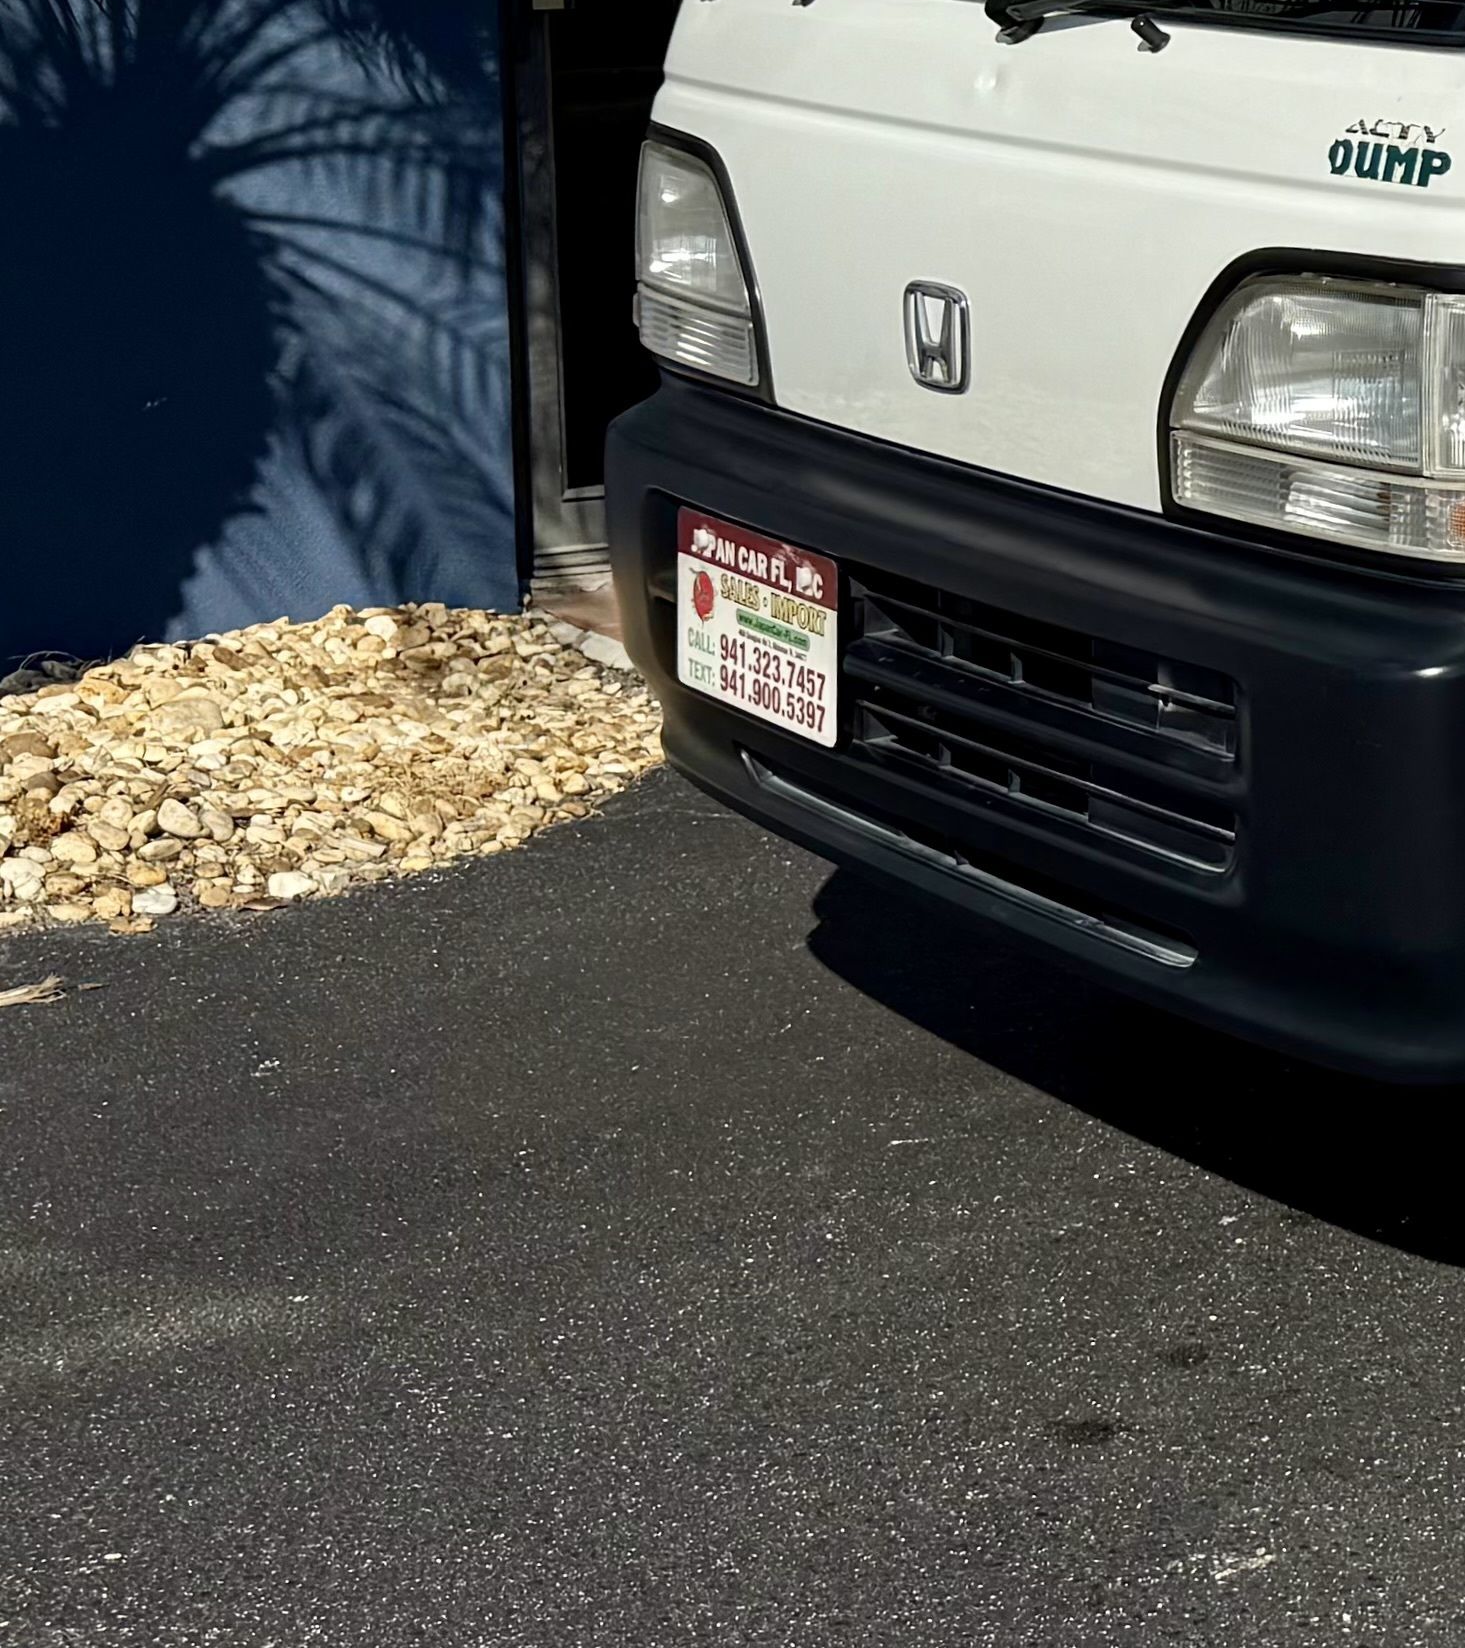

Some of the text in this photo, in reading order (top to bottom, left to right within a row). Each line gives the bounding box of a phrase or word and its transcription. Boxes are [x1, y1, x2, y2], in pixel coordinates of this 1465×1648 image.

[738, 545, 768, 581] CAR
[771, 558, 793, 593] FL,
[720, 573, 827, 636] SALES IMPORT
[687, 626, 716, 656] CALL:
[720, 634, 826, 701] 941.323.7457
[687, 657, 826, 733] TEXT: 941.900.5397
